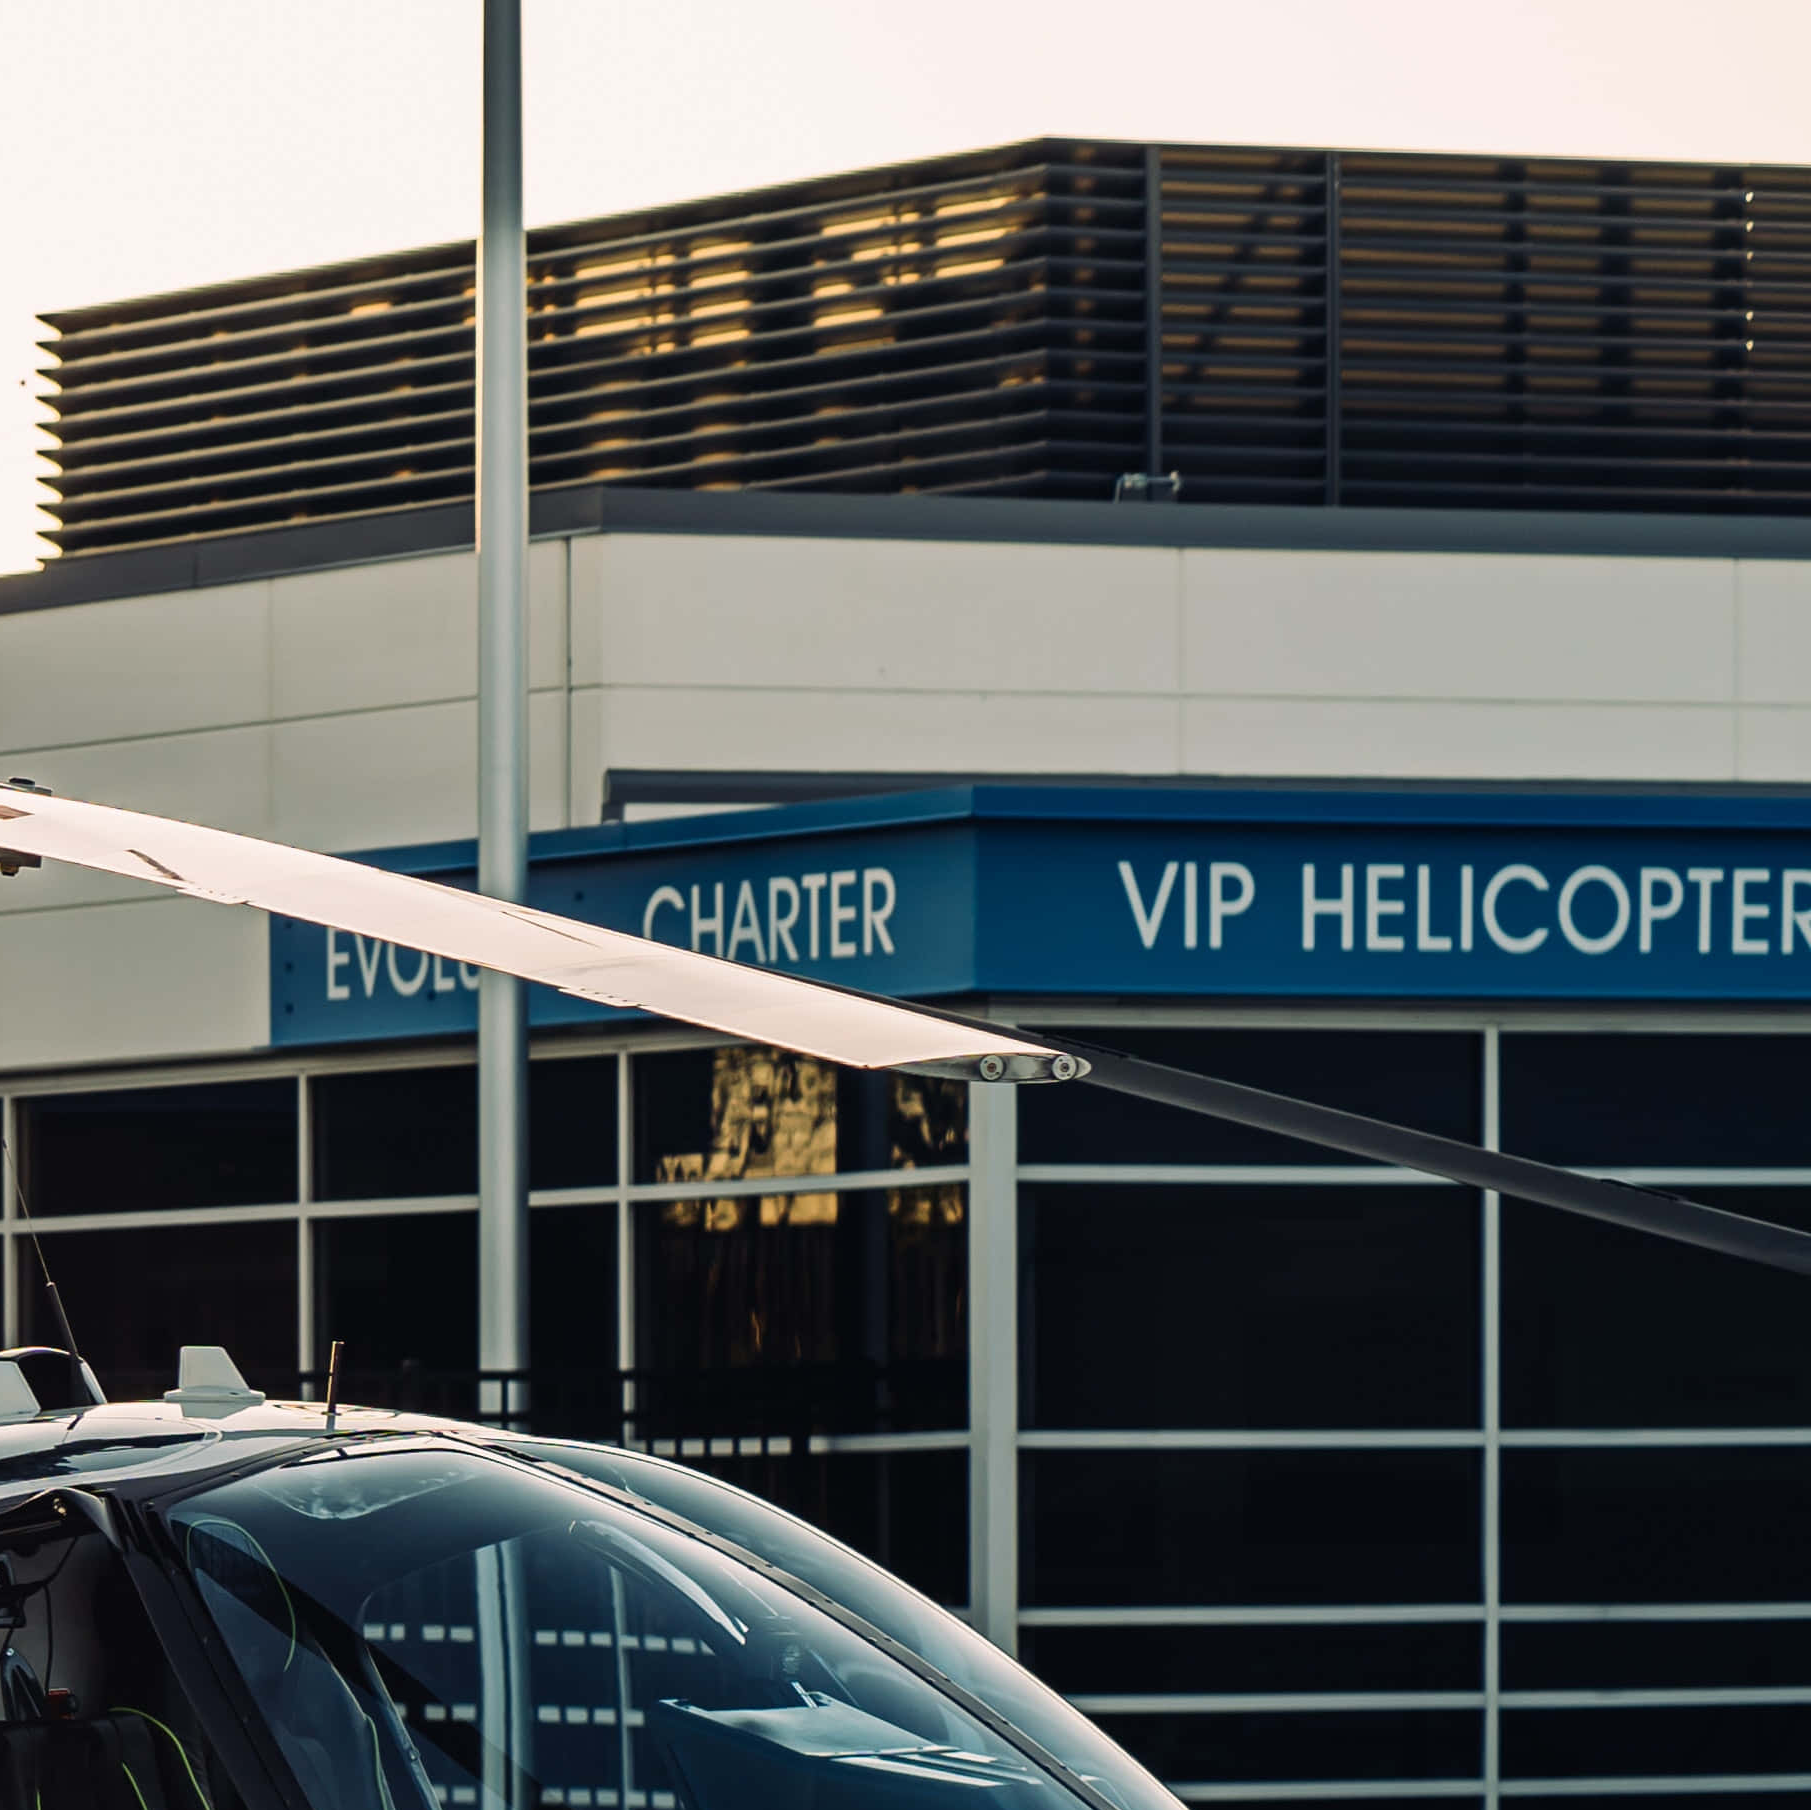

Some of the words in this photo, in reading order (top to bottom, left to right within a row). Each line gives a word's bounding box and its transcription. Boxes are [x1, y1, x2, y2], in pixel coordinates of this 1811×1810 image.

[643, 867, 896, 965] CHARTER
[1118, 860, 1255, 951] VIP
[1302, 863, 1811, 956] HELICOPTER
